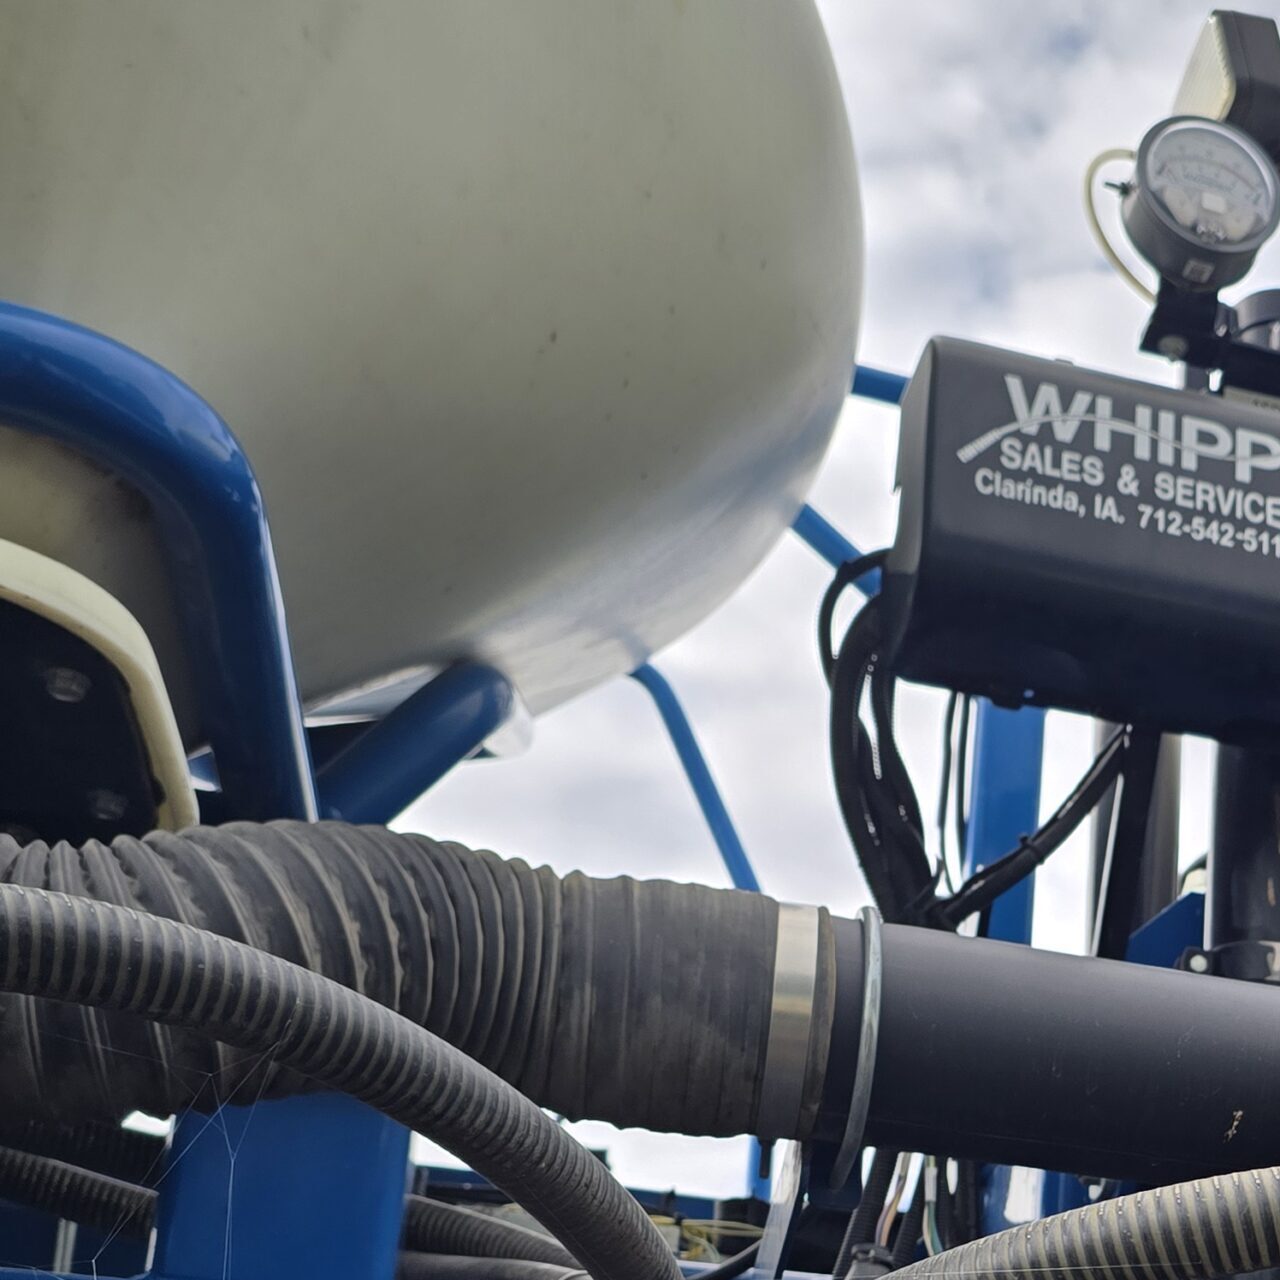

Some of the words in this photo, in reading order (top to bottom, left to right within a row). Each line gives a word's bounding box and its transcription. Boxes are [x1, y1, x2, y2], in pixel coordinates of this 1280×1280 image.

[975, 467, 1086, 518] Clarinda,
[1095, 496, 1125, 524] IA.
[1000, 437, 1104, 486] SALES
[1117, 464, 1140, 496] &
